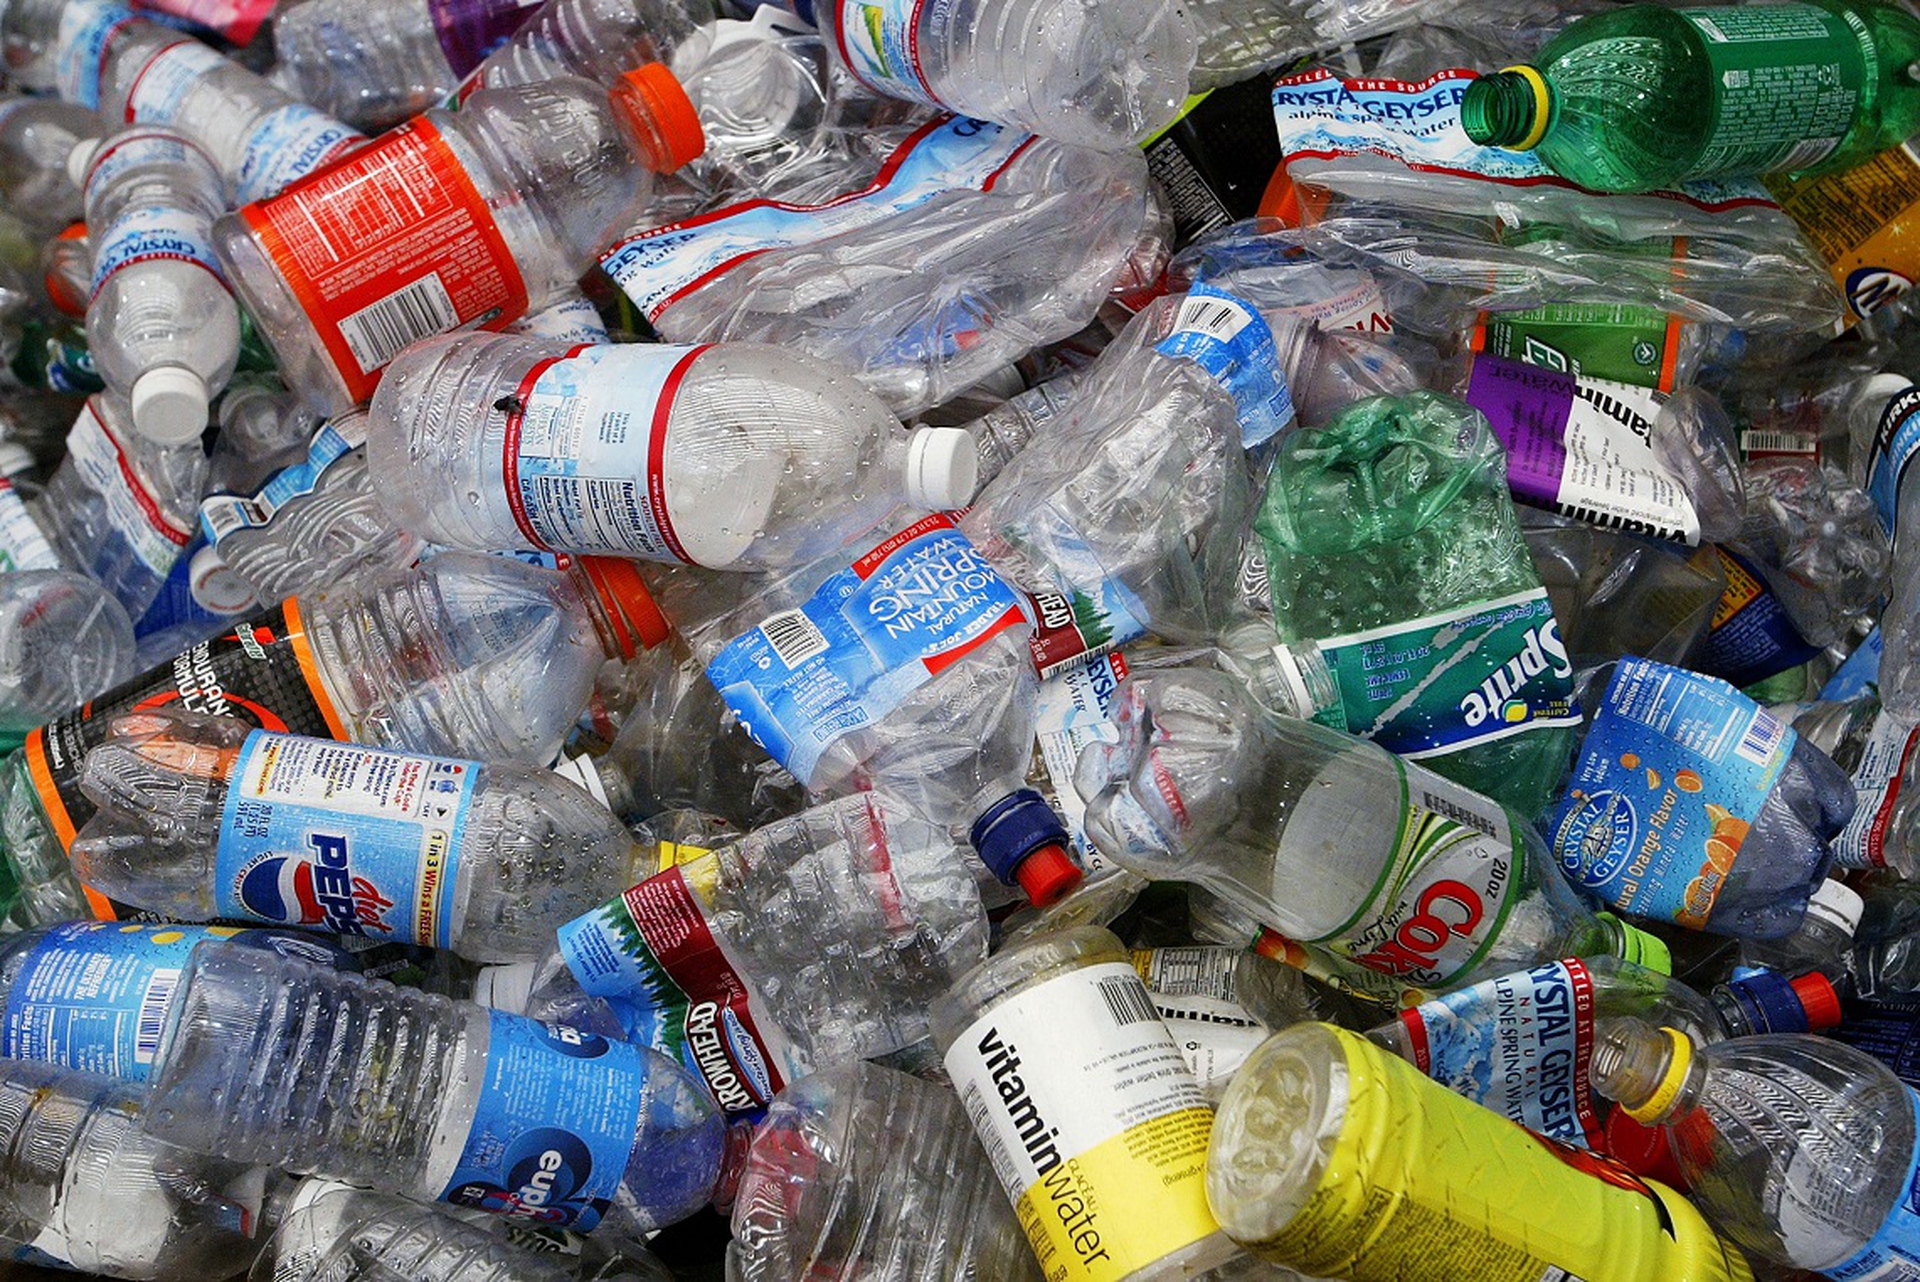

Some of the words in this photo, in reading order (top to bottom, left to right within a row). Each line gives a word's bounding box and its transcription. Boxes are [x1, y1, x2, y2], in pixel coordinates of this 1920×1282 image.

[1272, 87, 1358, 106] RYSTA
[1357, 81, 1386, 90] THE
[1398, 69, 1456, 92] SOURCE
[1402, 116, 1457, 138] water
[124, 238, 196, 257] CRYSTAL
[622, 481, 642, 530] Nutrition
[878, 537, 958, 590] WATER
[886, 569, 998, 639] MOUNTAIN
[925, 591, 990, 635] NATURAL
[963, 600, 1006, 635] TRADER
[192, 640, 235, 718] ENDURAN
[1460, 617, 1574, 728] Sprite
[1563, 803, 1603, 871] CRYSTAL
[1592, 810, 1631, 879] GEYSER
[1628, 830, 1662, 879] Orange
[1650, 787, 1680, 831] Flavor
[306, 833, 368, 937] PEPS
[351, 877, 394, 934] diet
[422, 871, 438, 901] Wins
[1494, 977, 1516, 1026] LPINE
[1528, 961, 1572, 1047] RYSTAL
[688, 1000, 759, 1113] RROWHEAD
[1501, 1027, 1523, 1085] SPRING
[1576, 1041, 1590, 1063] THE
[1539, 1049, 1578, 1140] GEYSER
[1576, 1069, 1592, 1119] SOURCE
[976, 1026, 1112, 1267] vitaminwater
[519, 1149, 563, 1220] euph
[1066, 1156, 1100, 1210] GLACÉAU
